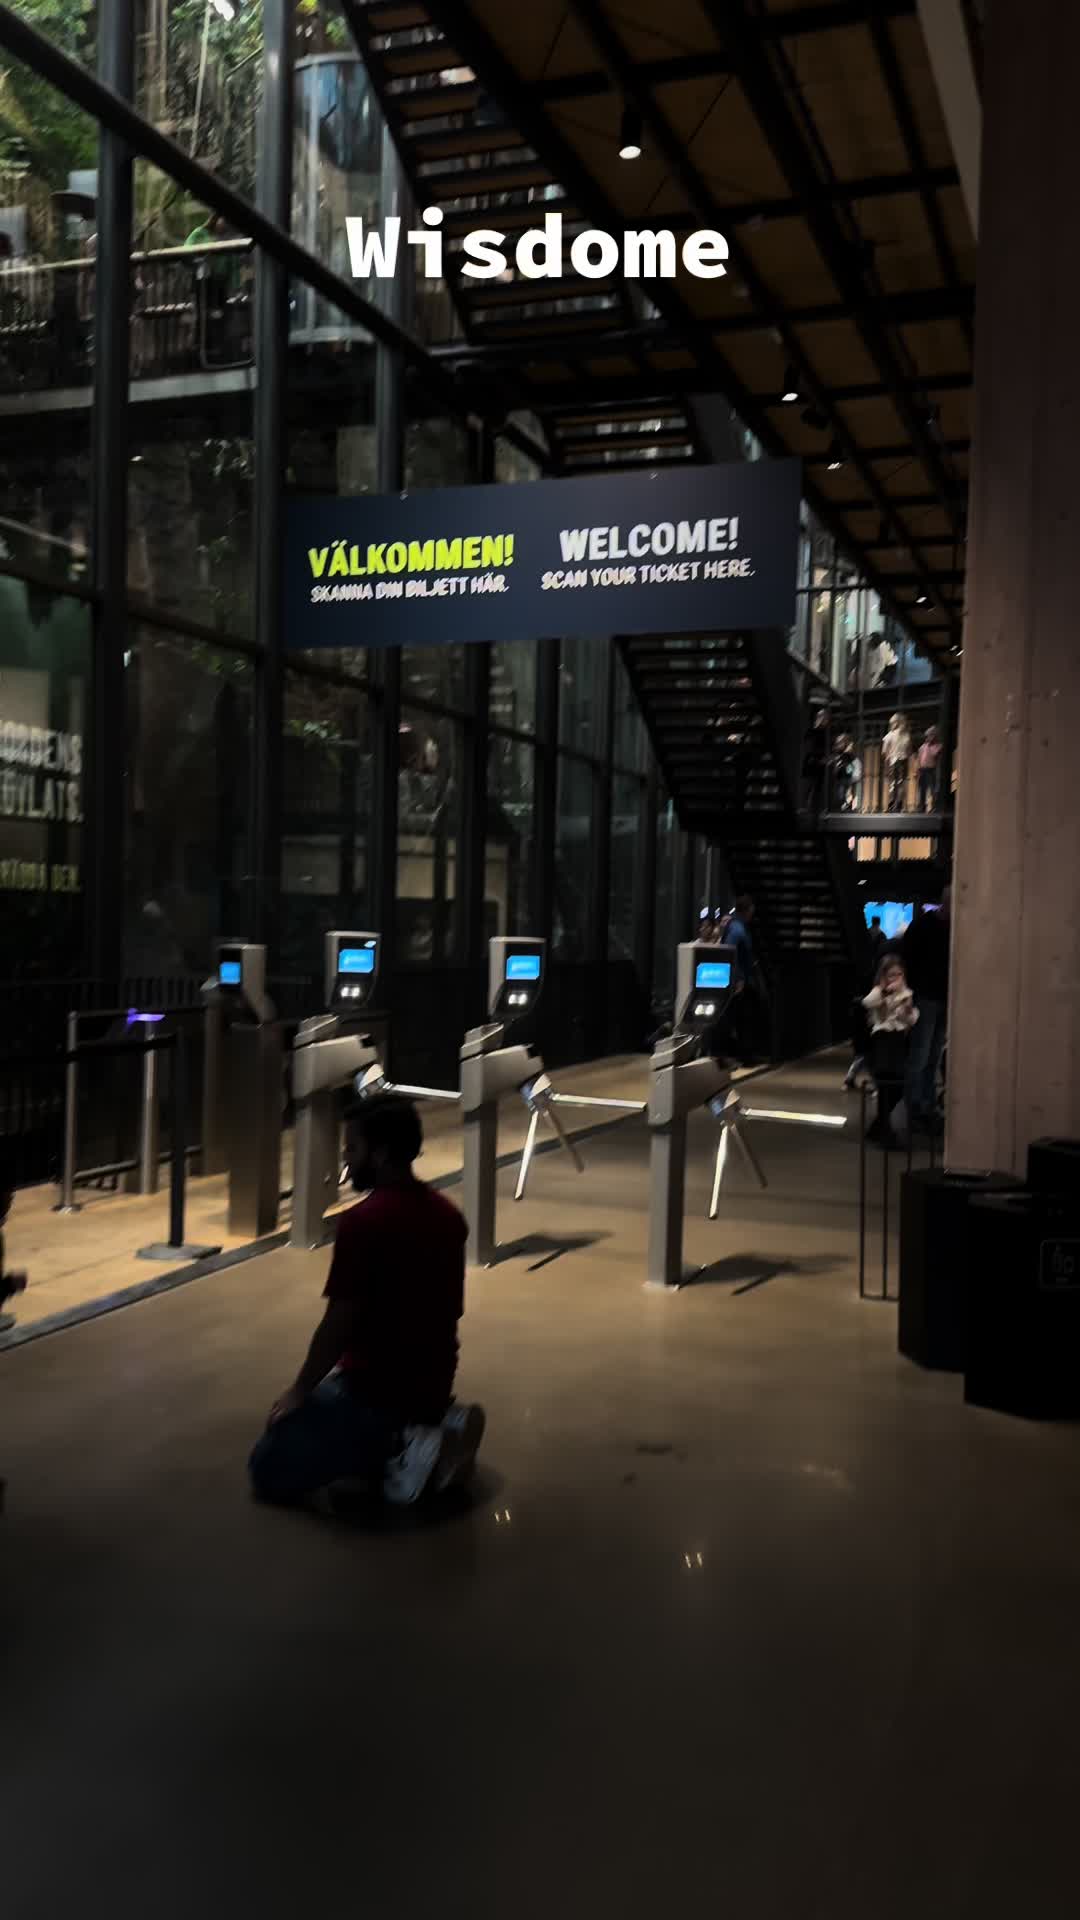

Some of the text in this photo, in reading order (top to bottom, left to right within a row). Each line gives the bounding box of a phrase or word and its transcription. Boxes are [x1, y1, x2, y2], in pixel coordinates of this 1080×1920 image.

[308, 533, 515, 578] VÄLKOMMEN!
[559, 516, 739, 563] WELCOME!
[310, 583, 374, 603] SKANNA
[375, 580, 404, 599] DIN
[405, 576, 469, 598] BILJETT
[540, 569, 588, 591] SCAN
[590, 565, 637, 587] YOUR
[638, 560, 702, 584] TICKET
